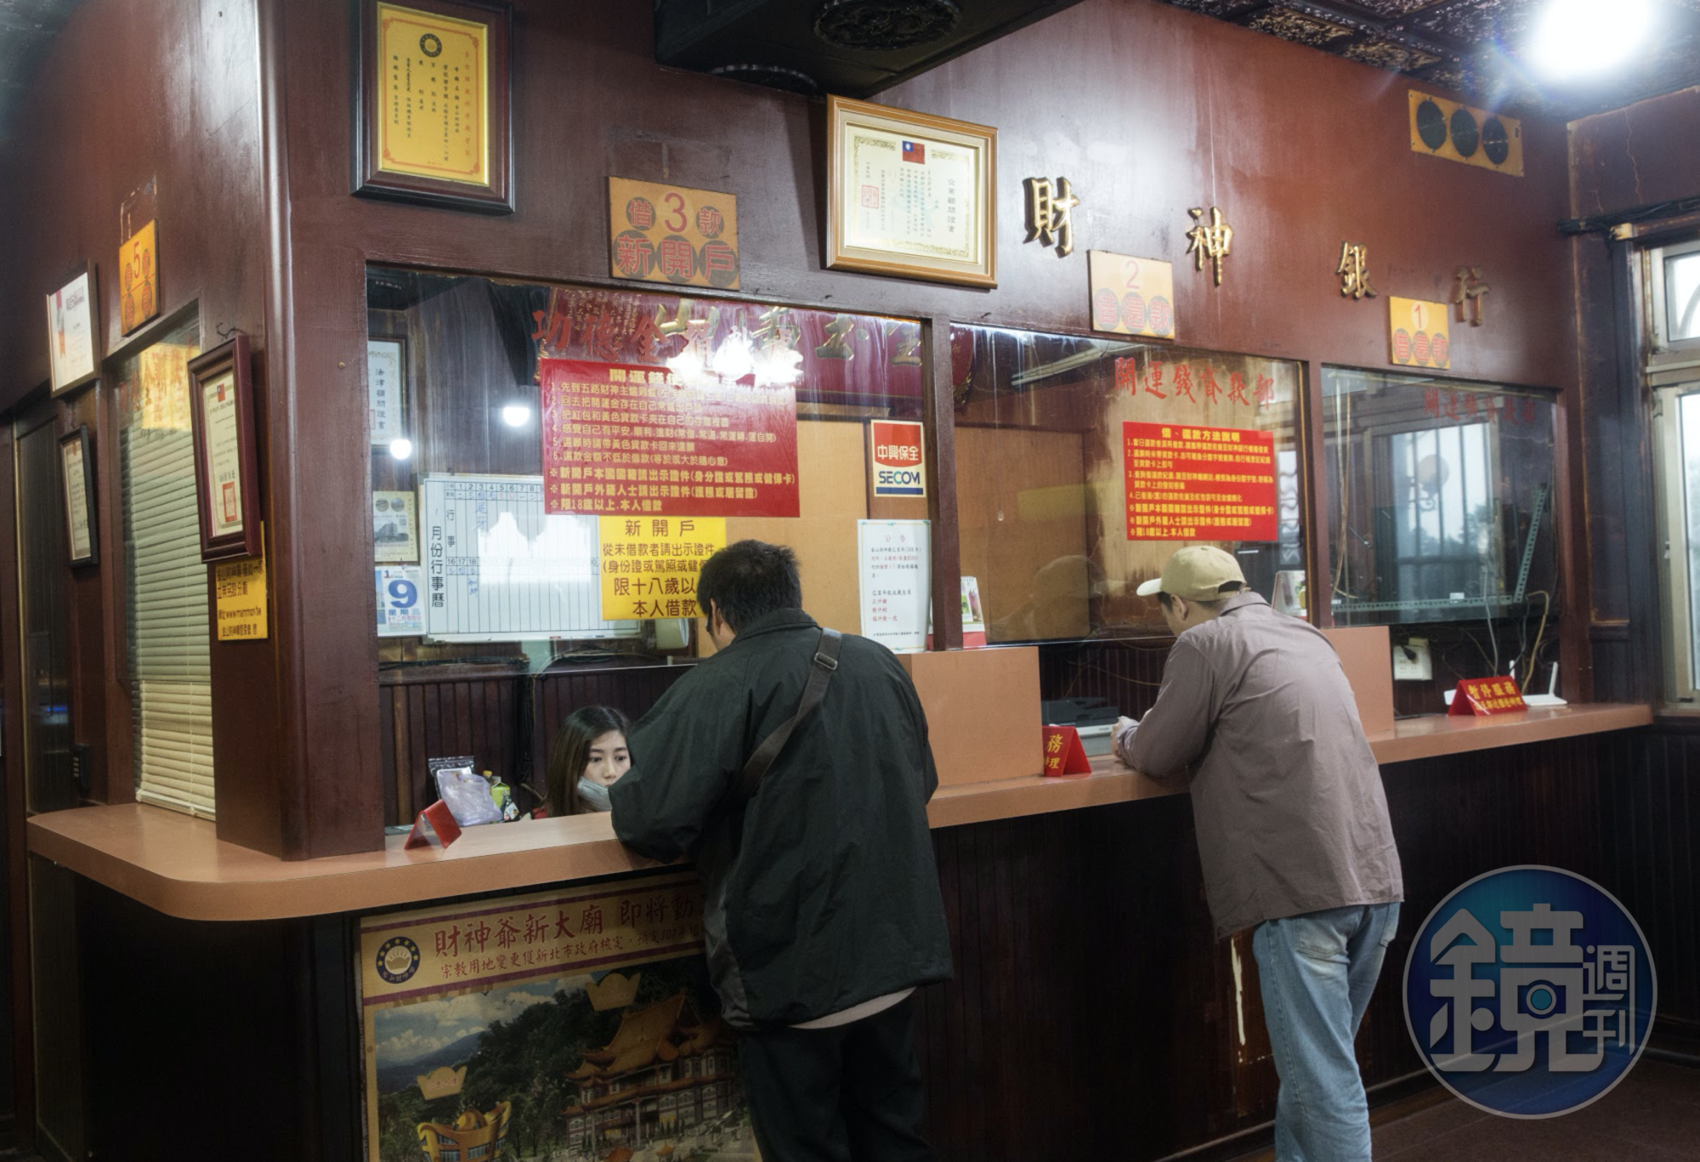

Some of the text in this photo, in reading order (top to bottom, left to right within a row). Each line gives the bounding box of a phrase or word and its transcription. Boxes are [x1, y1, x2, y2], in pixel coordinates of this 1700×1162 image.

[629, 192, 720, 235] 借 3 款
[133, 241, 140, 279] 5
[617, 234, 734, 280] 新開戶
[1125, 260, 1140, 290] 2
[1094, 293, 1171, 330] 借還款
[1414, 304, 1421, 328] 1
[1115, 356, 1274, 411] 開運錢貸款部
[877, 444, 919, 460] 中興保全
[879, 470, 920, 484] SECOM
[625, 519, 695, 537] 新開戶
[602, 542, 715, 557] 從未借款者請出示證件
[431, 526, 444, 608] 月份行事曆
[388, 579, 417, 608] 9
[388, 608, 420, 616] 星期三
[632, 599, 697, 618] 本人借款
[1468, 681, 1516, 699] 暫停服務
[434, 904, 603, 960] 財神爺新大廟
